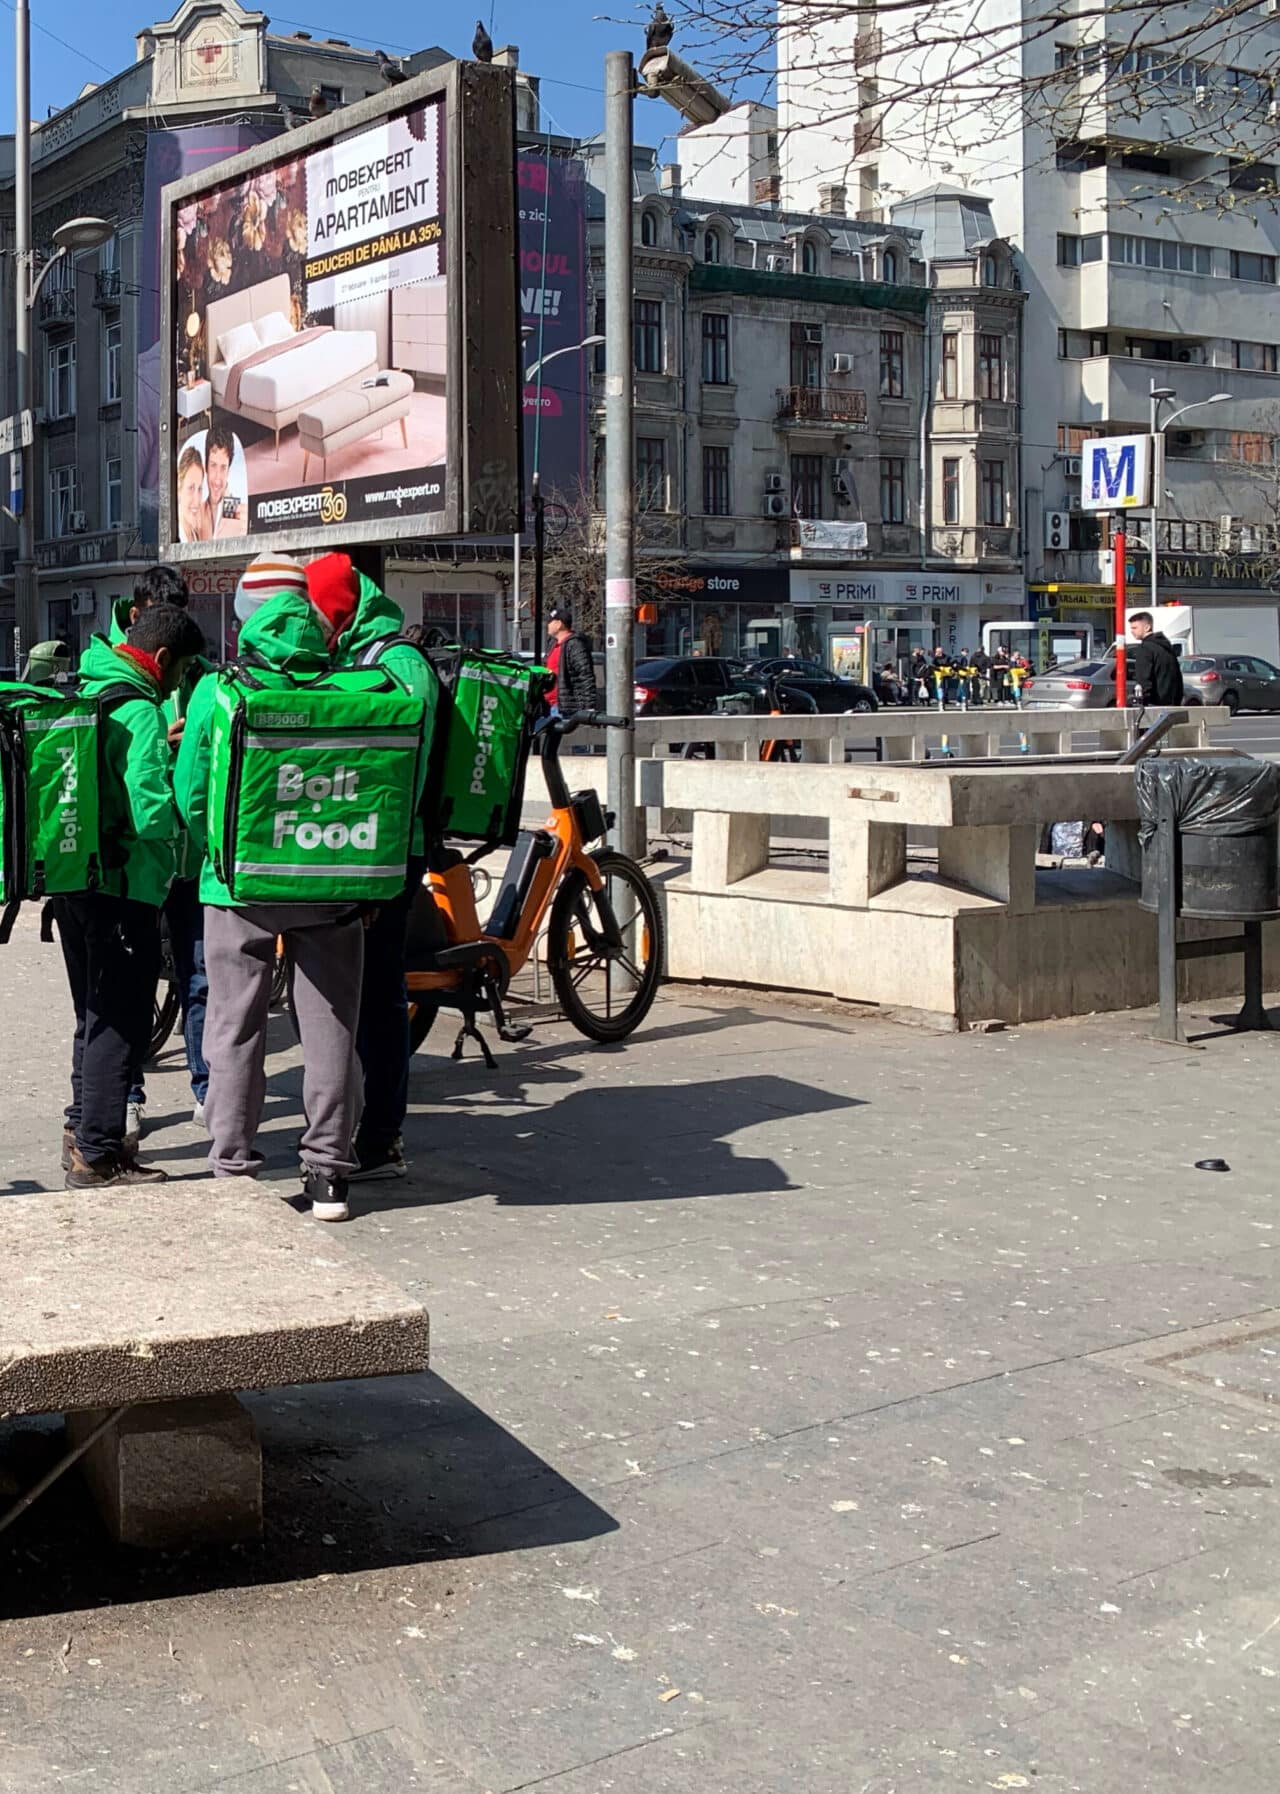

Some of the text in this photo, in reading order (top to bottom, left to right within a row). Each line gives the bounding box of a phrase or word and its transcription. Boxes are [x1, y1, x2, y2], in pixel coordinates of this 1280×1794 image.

[326, 147, 413, 198] MOBEXPERT
[314, 179, 430, 242] APARTAMENT
[305, 222, 442, 279] REDUCERI DE PÂNĂ LA 35%
[365, 483, 440, 503] www.mobexpert.ro
[1092, 445, 1136, 499] M
[257, 493, 321, 518] MOBEXPERT
[320, 486, 347, 524] 30
[707, 576, 740, 590] store
[470, 695, 498, 795] Bolt Food
[57, 747, 82, 854] Bolt Food
[276, 763, 360, 811] Bolt
[272, 811, 379, 850] Food
